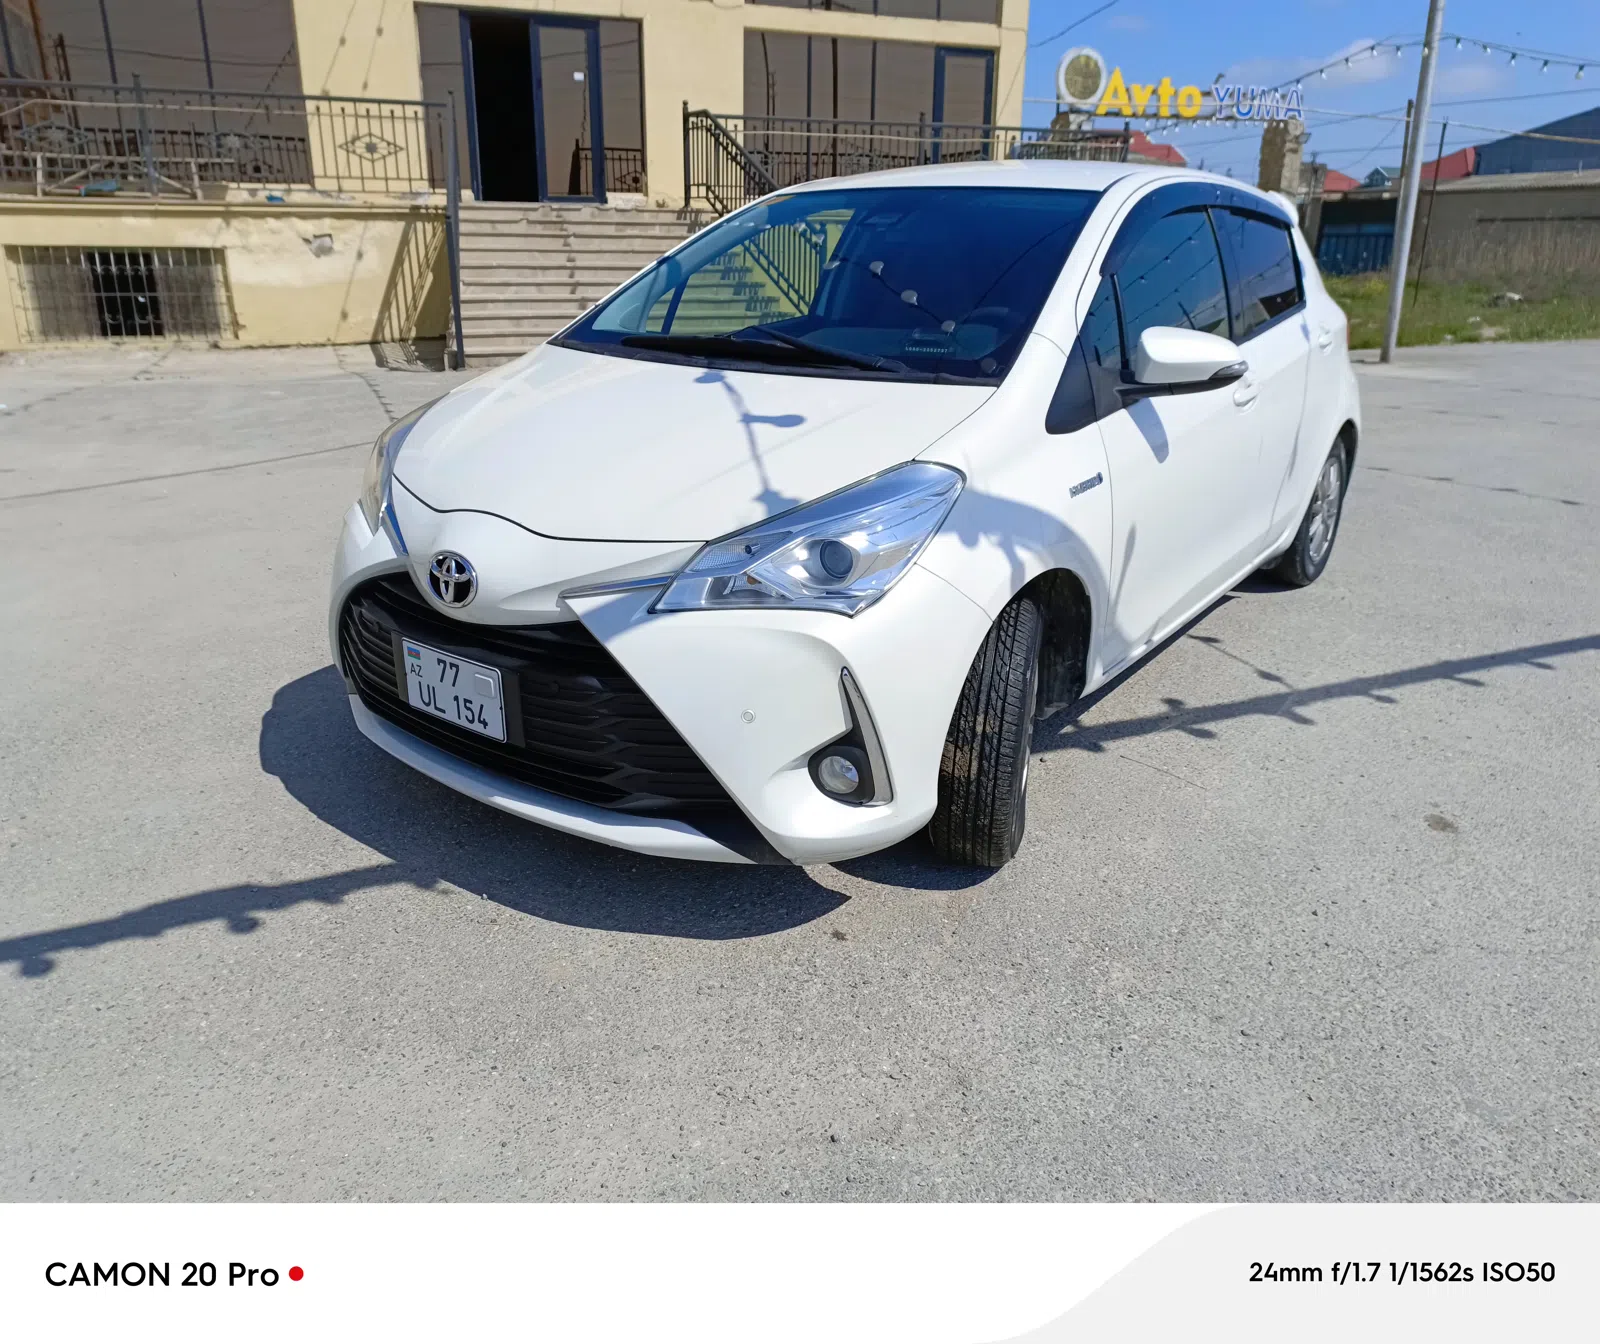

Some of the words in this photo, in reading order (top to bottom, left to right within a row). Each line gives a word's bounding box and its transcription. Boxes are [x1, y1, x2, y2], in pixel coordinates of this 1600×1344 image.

[1096, 66, 1203, 118] Avto
[1213, 85, 1303, 119] YUMA
[410, 663, 423, 678] AZ
[437, 658, 460, 687] 77
[419, 681, 446, 714] UL
[453, 695, 488, 729] 154
